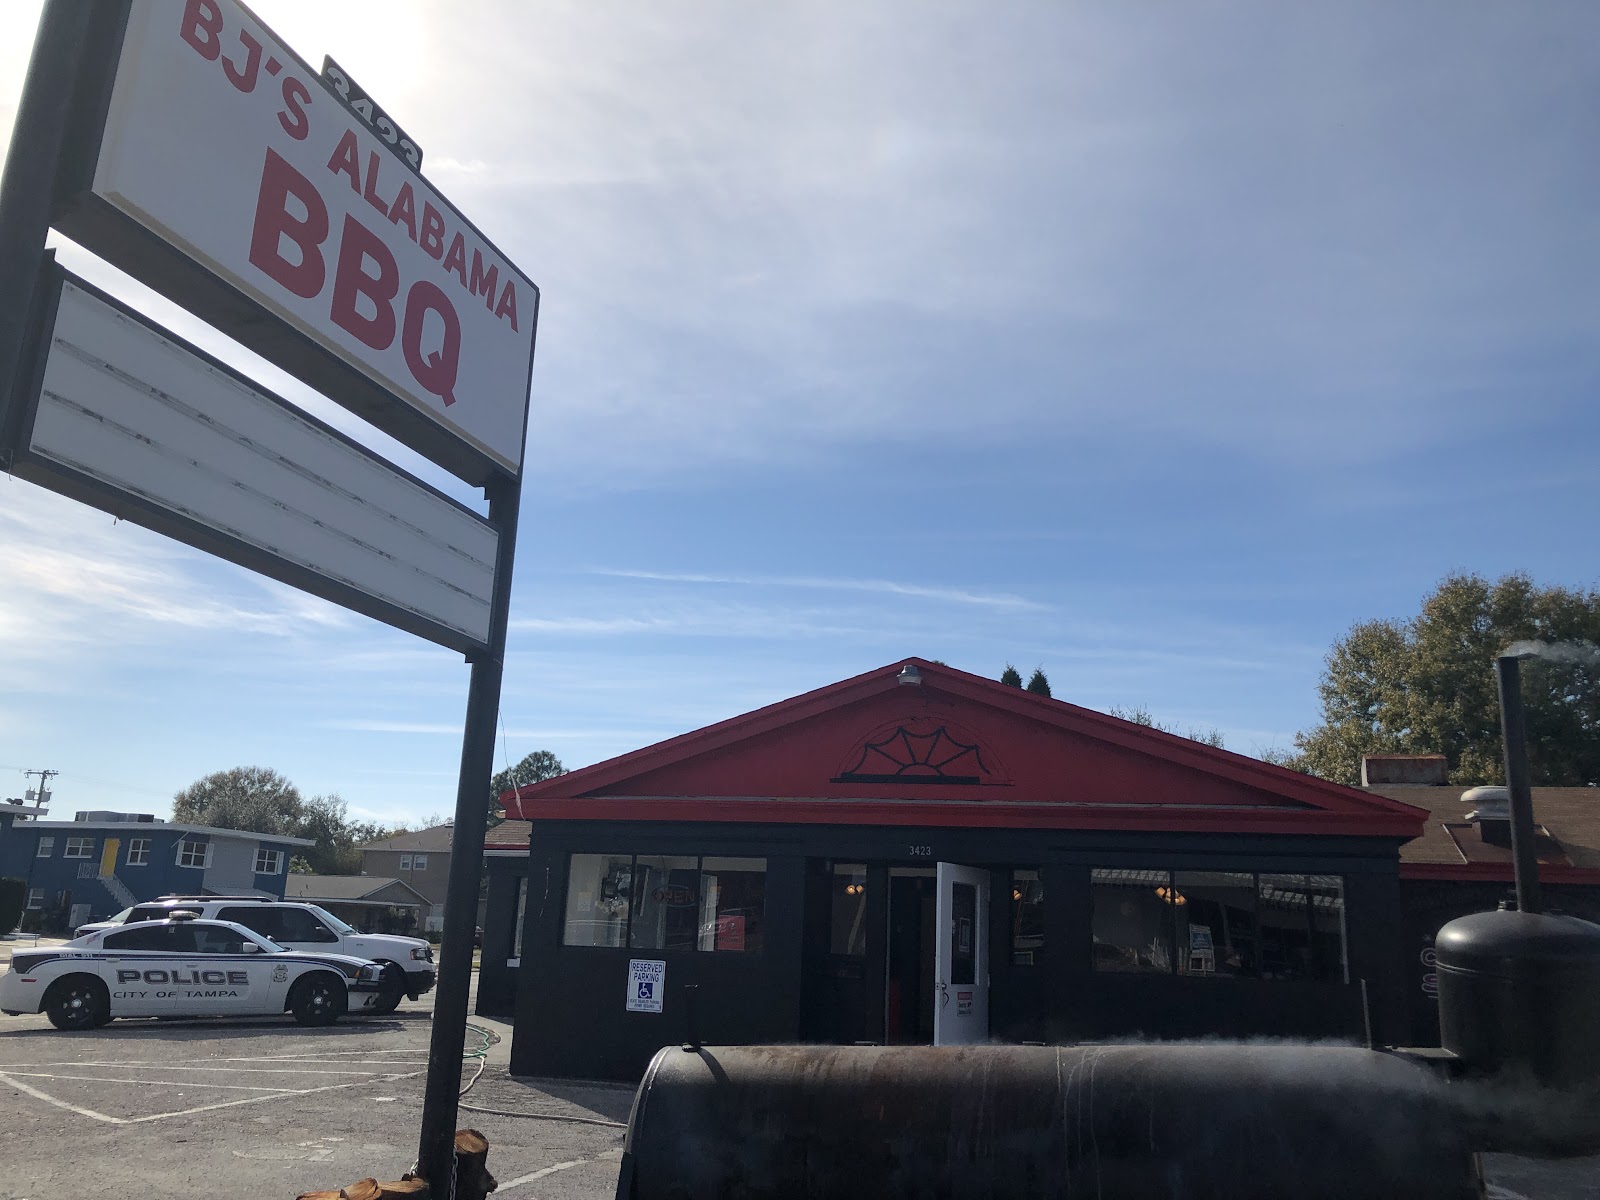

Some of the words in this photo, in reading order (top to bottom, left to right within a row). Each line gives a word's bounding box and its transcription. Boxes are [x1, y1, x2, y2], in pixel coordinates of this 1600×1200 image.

[180, 0, 312, 141] BJ'S
[327, 128, 519, 334] ALABAMA
[248, 145, 462, 407] BBQ
[909, 845, 931, 856] 3423
[631, 962, 663, 974] RESERVED
[116, 969, 250, 986] POLICE
[633, 972, 660, 982] PARKING
[113, 991, 148, 999] CITY
[185, 990, 238, 998] TAMPA
